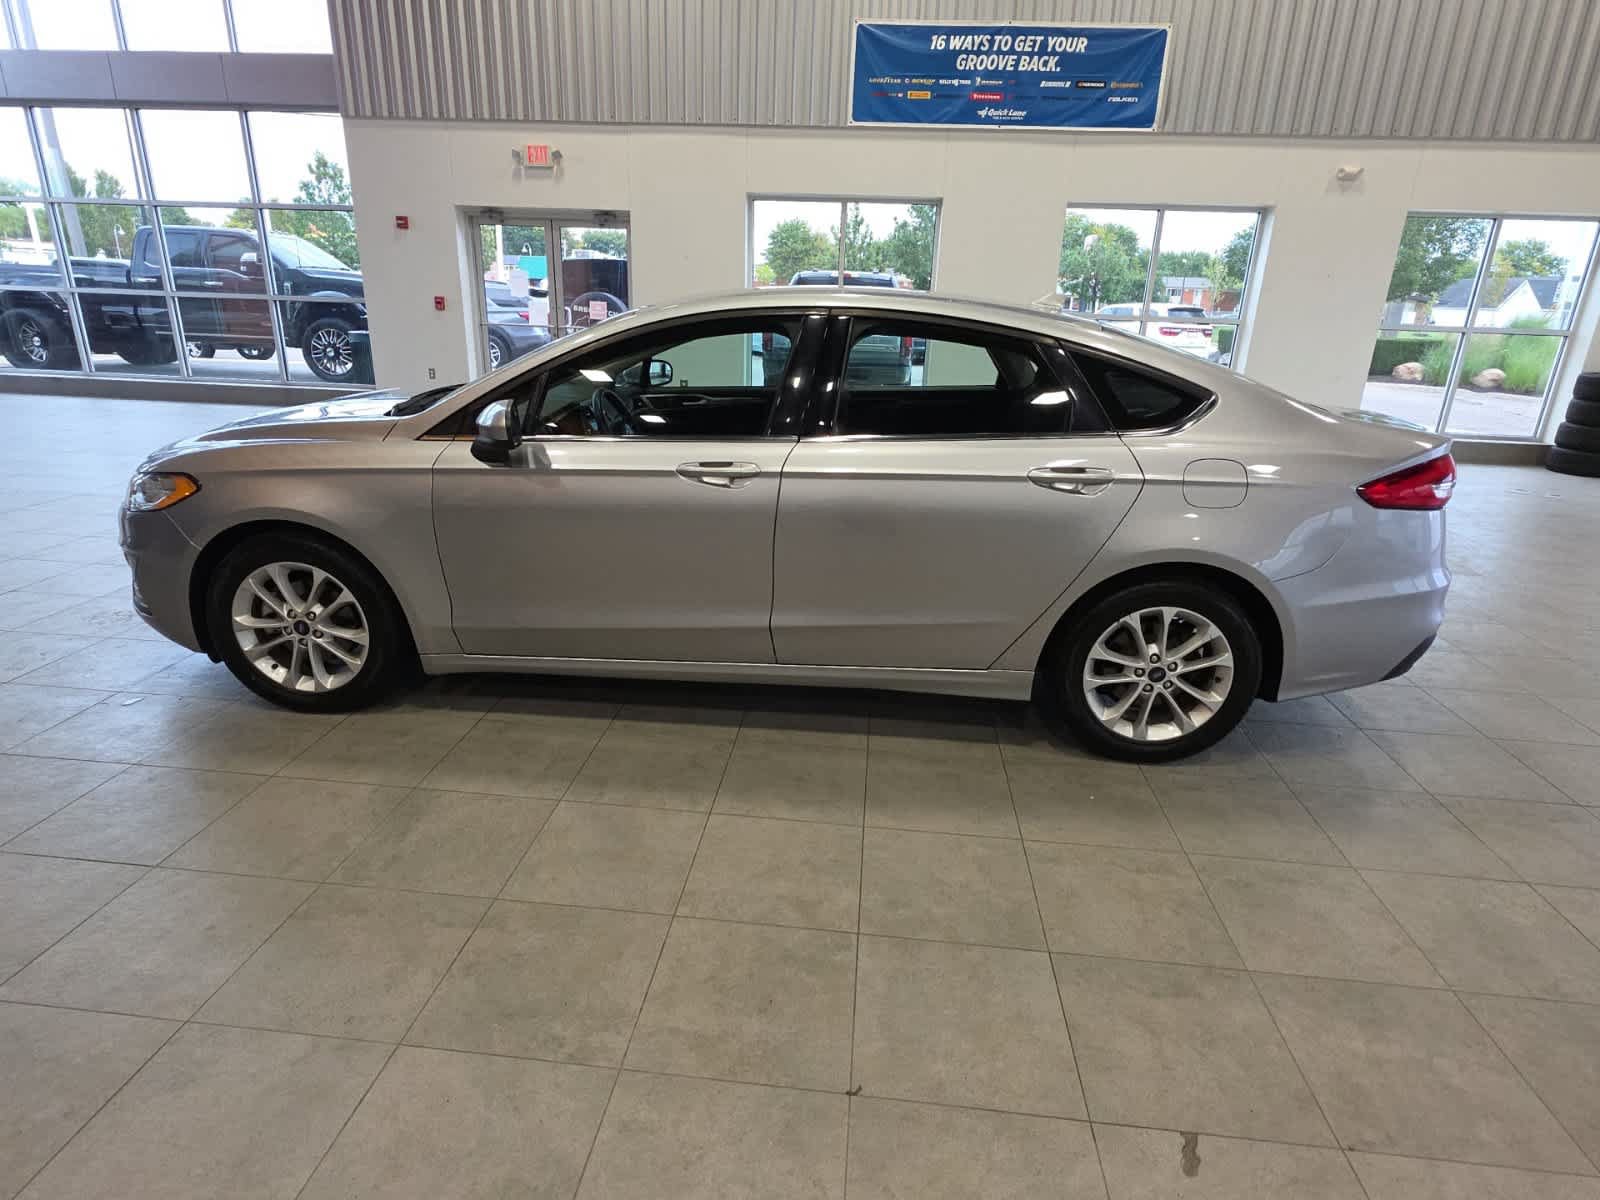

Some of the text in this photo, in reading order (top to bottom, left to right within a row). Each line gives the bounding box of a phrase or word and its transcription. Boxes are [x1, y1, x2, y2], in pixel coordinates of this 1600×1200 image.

[930, 34, 1088, 53] 16 WAYS TO GET YOUR
[956, 54, 1061, 72] GROOVE BACK.
[987, 108, 1026, 117] Quick Lane
